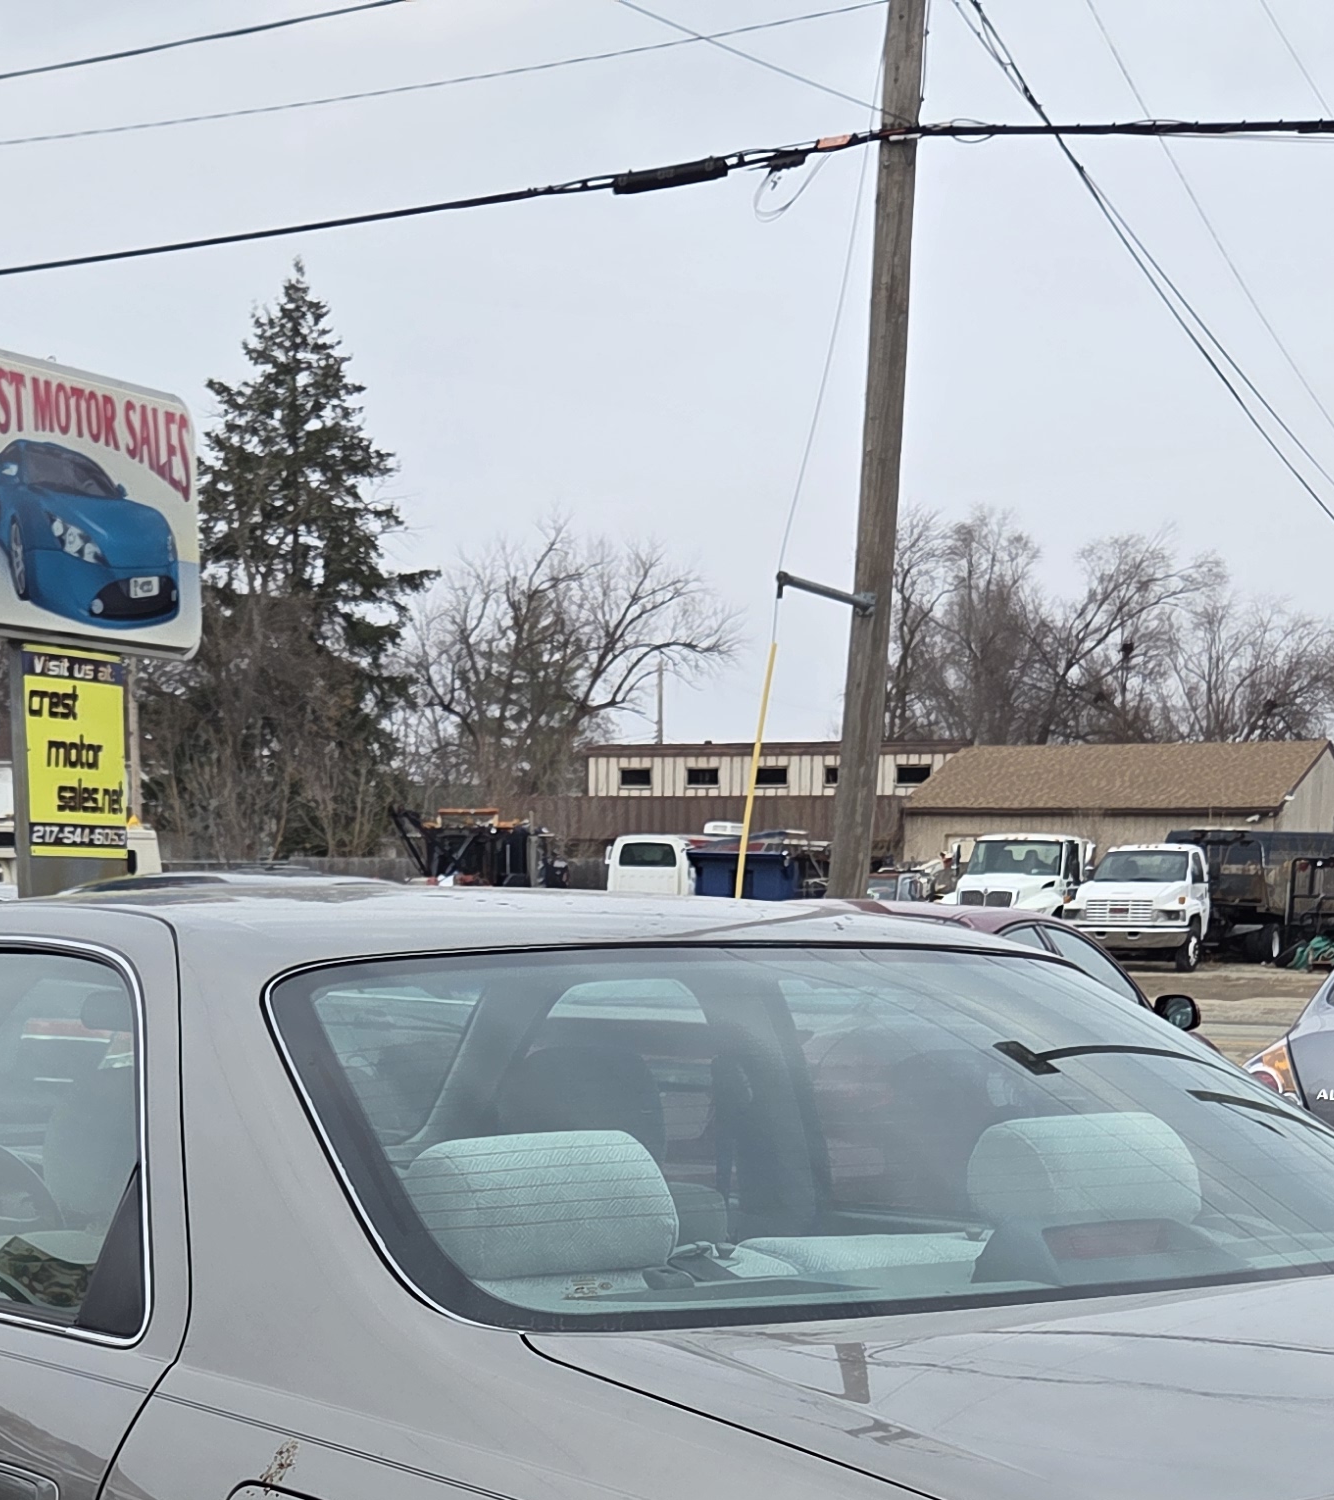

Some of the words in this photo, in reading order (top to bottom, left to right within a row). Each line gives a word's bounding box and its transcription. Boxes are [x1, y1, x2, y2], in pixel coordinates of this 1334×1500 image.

[31, 376, 121, 452] MOTOR
[124, 400, 191, 502] SALES
[33, 655, 70, 677] Visit
[73, 662, 95, 680] us
[28, 684, 79, 721] crest
[46, 733, 103, 771] motor
[56, 778, 124, 815] sales.net
